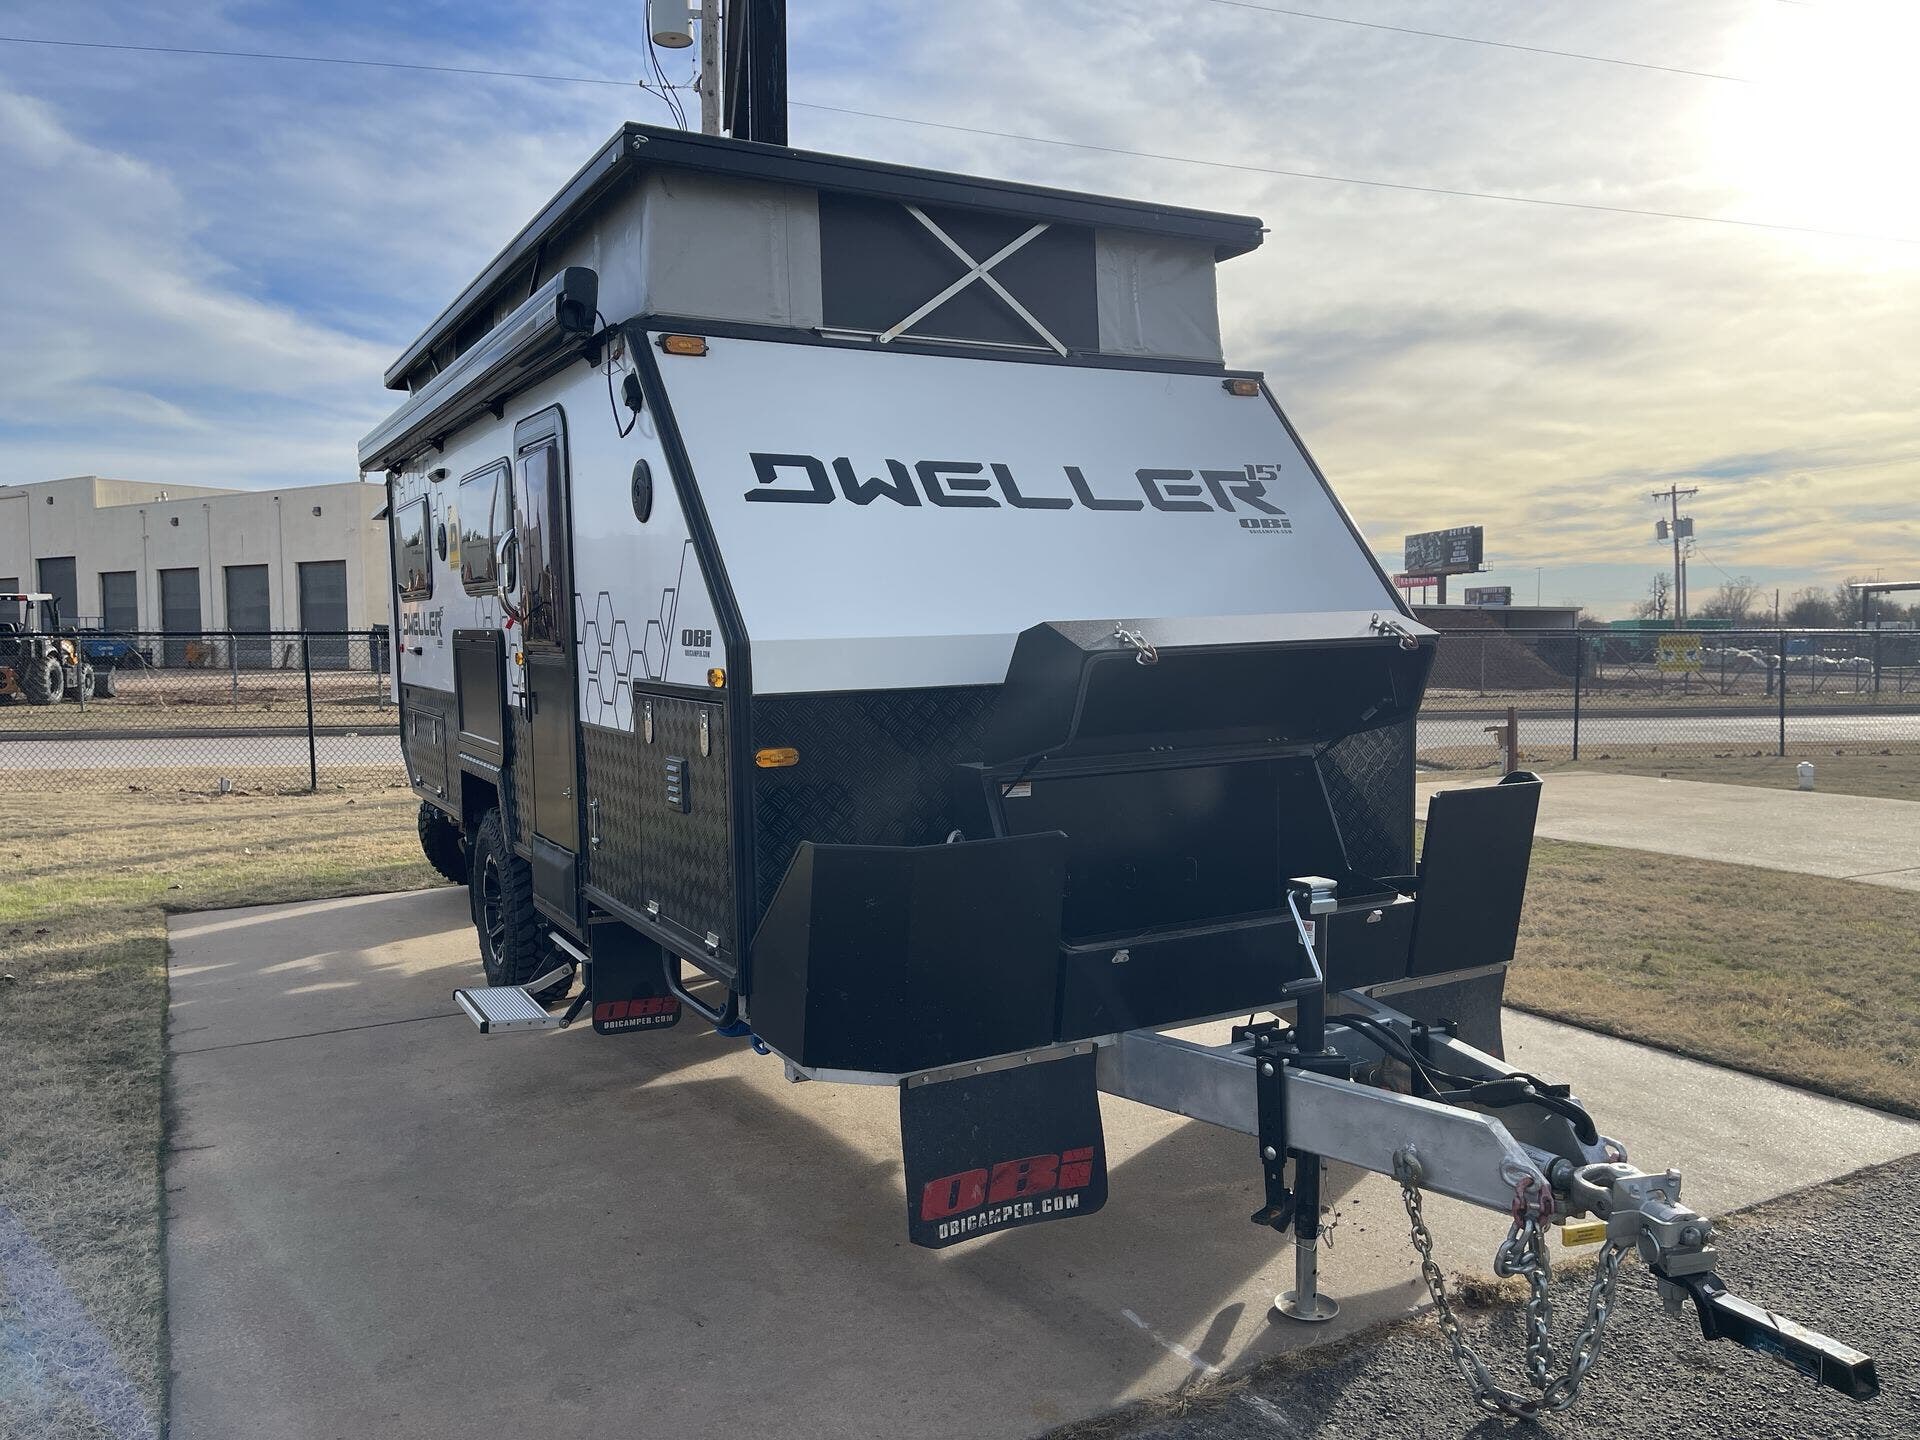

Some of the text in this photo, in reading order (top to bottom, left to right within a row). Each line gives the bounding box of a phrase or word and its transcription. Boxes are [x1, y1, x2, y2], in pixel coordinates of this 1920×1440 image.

[744, 452, 1286, 515] DWELLER
[603, 1014, 673, 1029] OBICAMPER.COM
[938, 1194, 1079, 1240] OBICAMPER.COM
